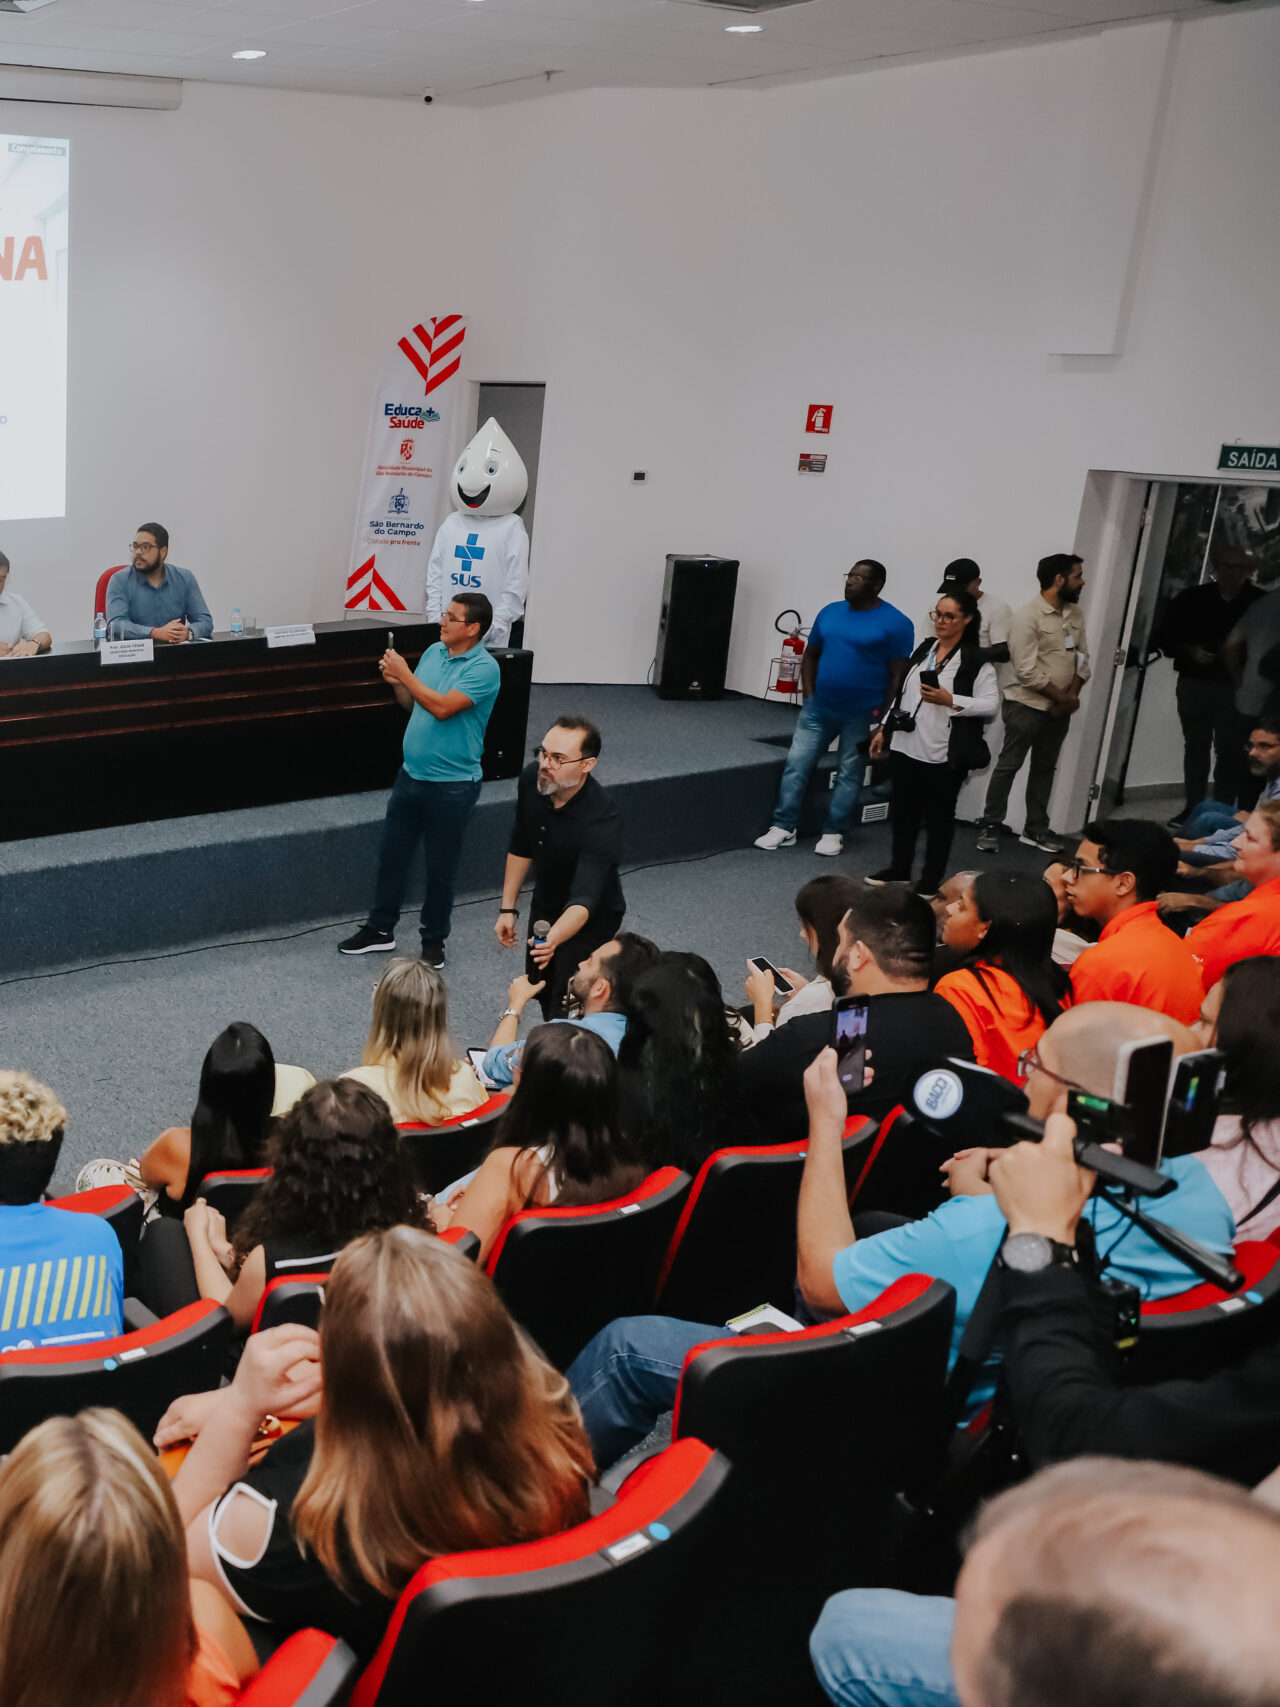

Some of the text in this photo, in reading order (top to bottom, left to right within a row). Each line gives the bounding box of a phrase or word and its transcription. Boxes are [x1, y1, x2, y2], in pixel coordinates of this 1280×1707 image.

[389, 416, 425, 429] Saúde
[1228, 449, 1277, 468] SAÍDA
[385, 521, 424, 530] Bernardo
[387, 529, 416, 537] Campo
[451, 573, 481, 588] SUS
